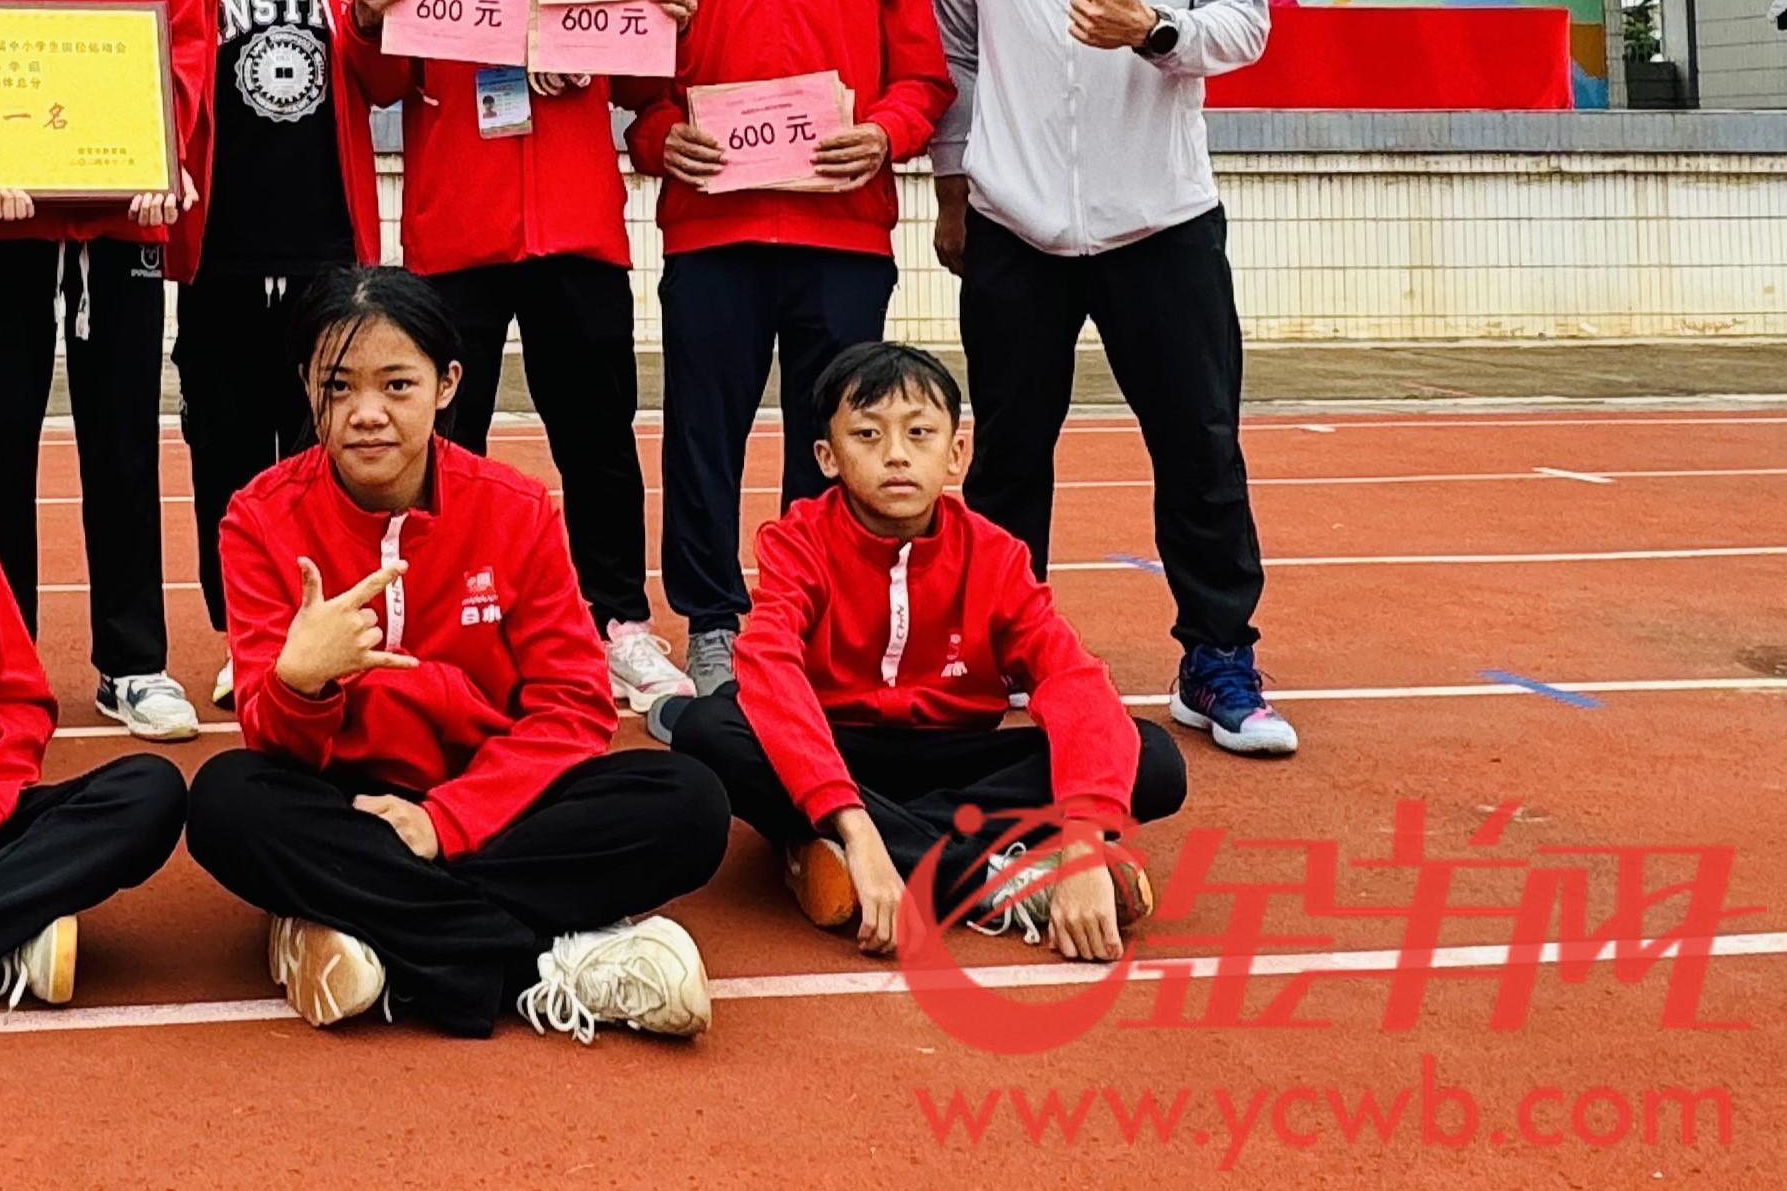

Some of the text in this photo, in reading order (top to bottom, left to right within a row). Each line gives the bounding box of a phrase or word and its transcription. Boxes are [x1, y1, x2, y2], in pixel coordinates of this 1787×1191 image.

[473, 0, 503, 27] 元
[561, 7, 649, 35] 600 元
[729, 114, 817, 150] 600 元
